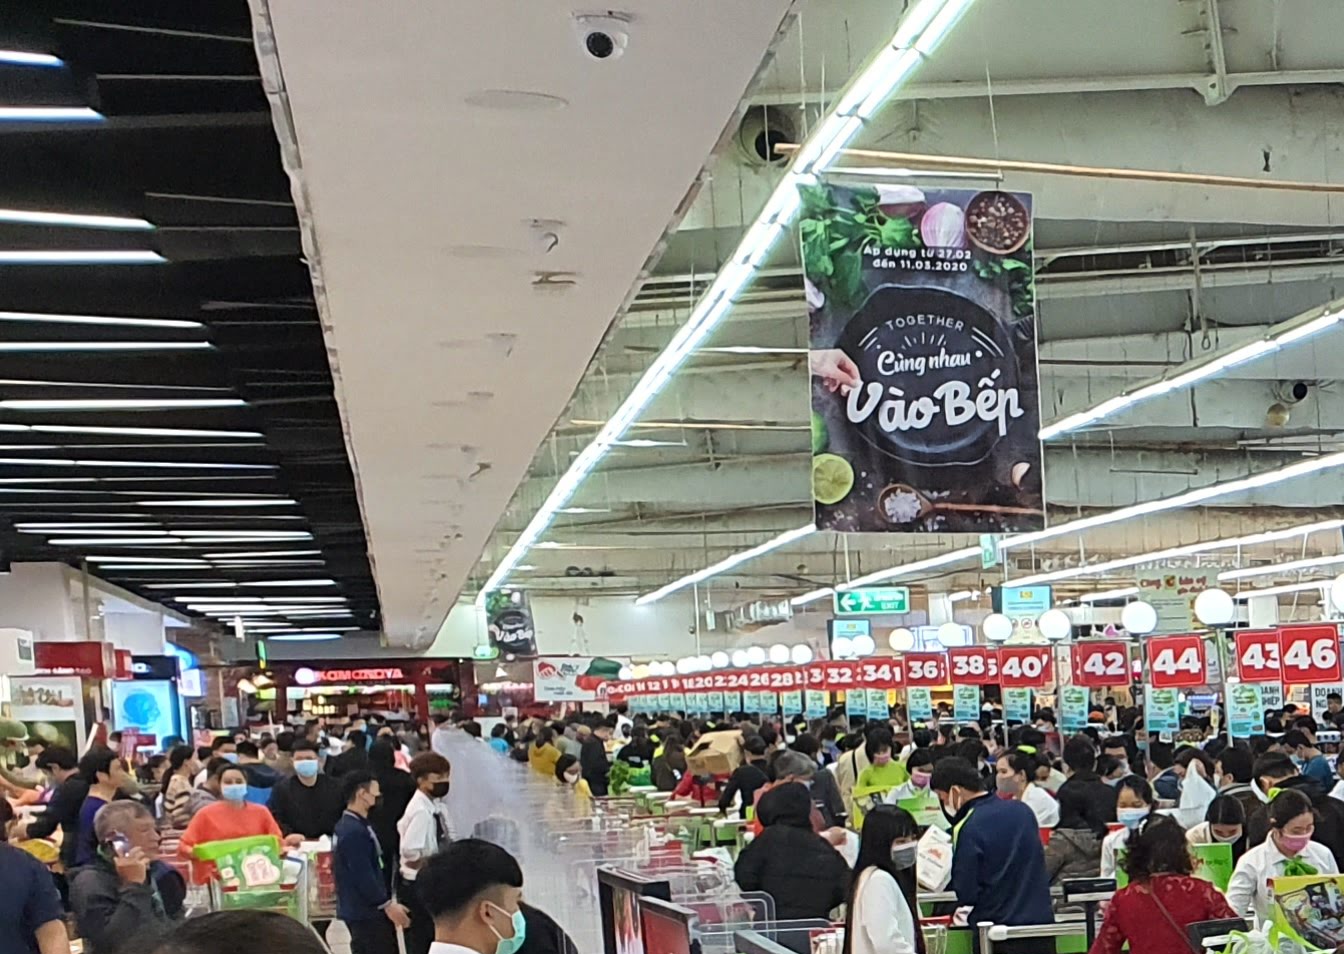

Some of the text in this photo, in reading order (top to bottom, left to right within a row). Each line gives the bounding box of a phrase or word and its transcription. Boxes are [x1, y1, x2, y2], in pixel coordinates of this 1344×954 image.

[936, 249, 972, 260] 27.02
[900, 260, 968, 271] 11.03.2020
[885, 314, 965, 331] TOGETHER
[877, 347, 971, 376] Cùng nhau
[846, 368, 1024, 436] Vào Bếp
[1084, 652, 1126, 677] 42
[1152, 647, 1202, 676] 44
[1241, 639, 1337, 671] 43 46
[864, 664, 891, 682] 34
[908, 659, 938, 679] 36
[953, 654, 986, 676] 38
[1002, 655, 1041, 679] 40
[695, 676, 713, 688] 20
[728, 674, 748, 687] 24
[770, 672, 794, 687] 28
[827, 667, 853, 684] 32
